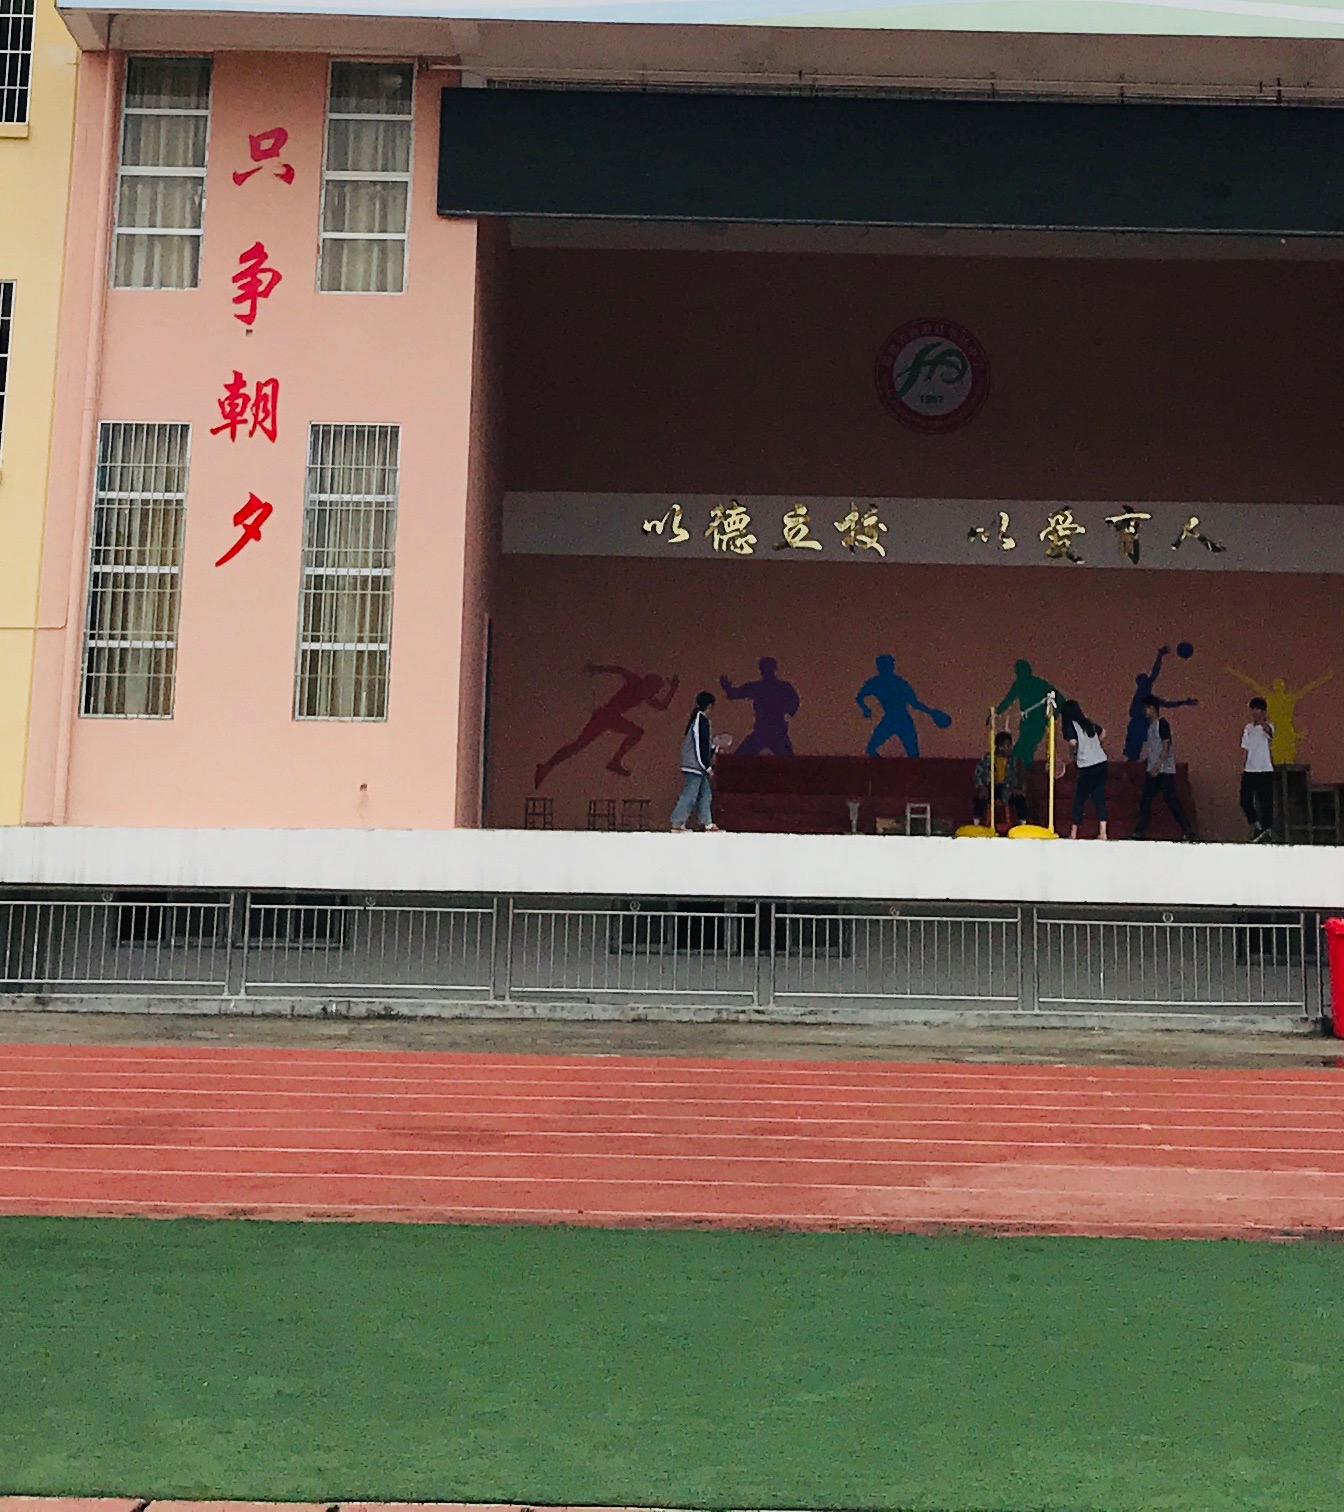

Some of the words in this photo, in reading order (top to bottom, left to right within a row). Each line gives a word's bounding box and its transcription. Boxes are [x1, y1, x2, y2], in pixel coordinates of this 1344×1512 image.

[210, 126, 295, 567] 只争朝夕
[642, 498, 889, 558] 以德立校
